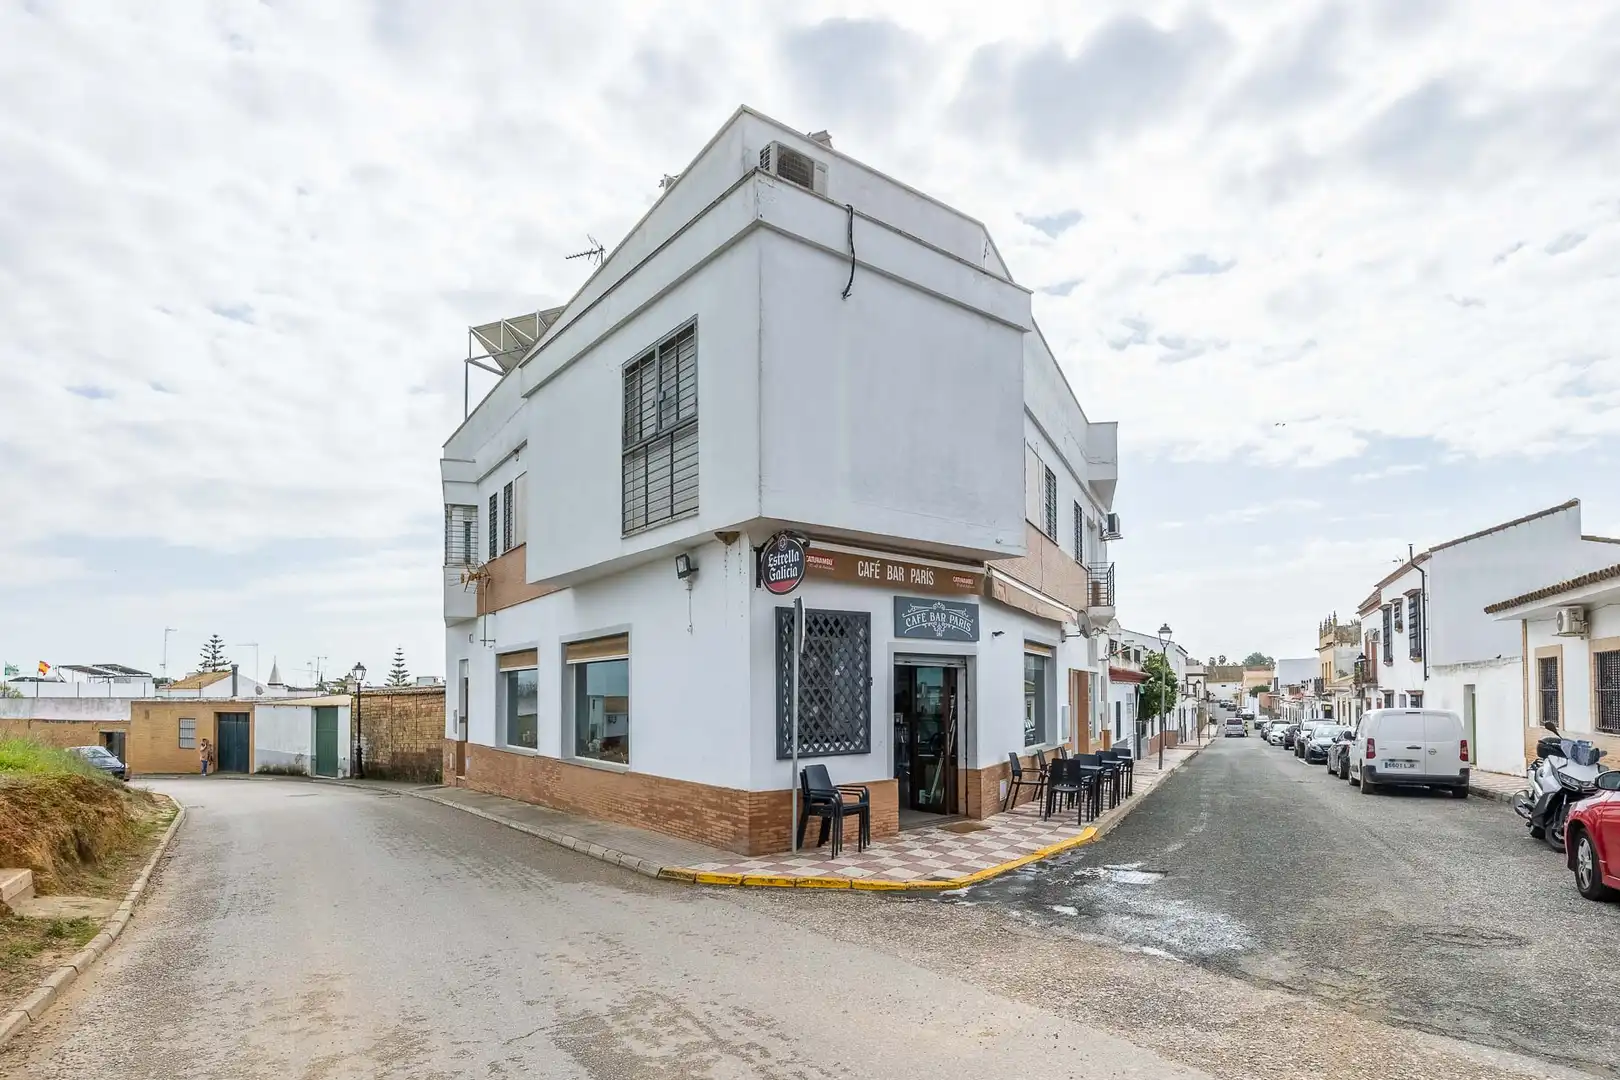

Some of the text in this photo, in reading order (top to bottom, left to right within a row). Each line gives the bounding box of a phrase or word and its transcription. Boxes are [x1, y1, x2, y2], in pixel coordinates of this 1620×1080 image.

[768, 549, 800, 567] Estrella
[769, 563, 798, 581] Galicia
[857, 560, 881, 579] CAFÉ
[886, 564, 905, 582] BAR
[910, 567, 934, 586] PARÍS
[929, 611, 947, 622] BAR
